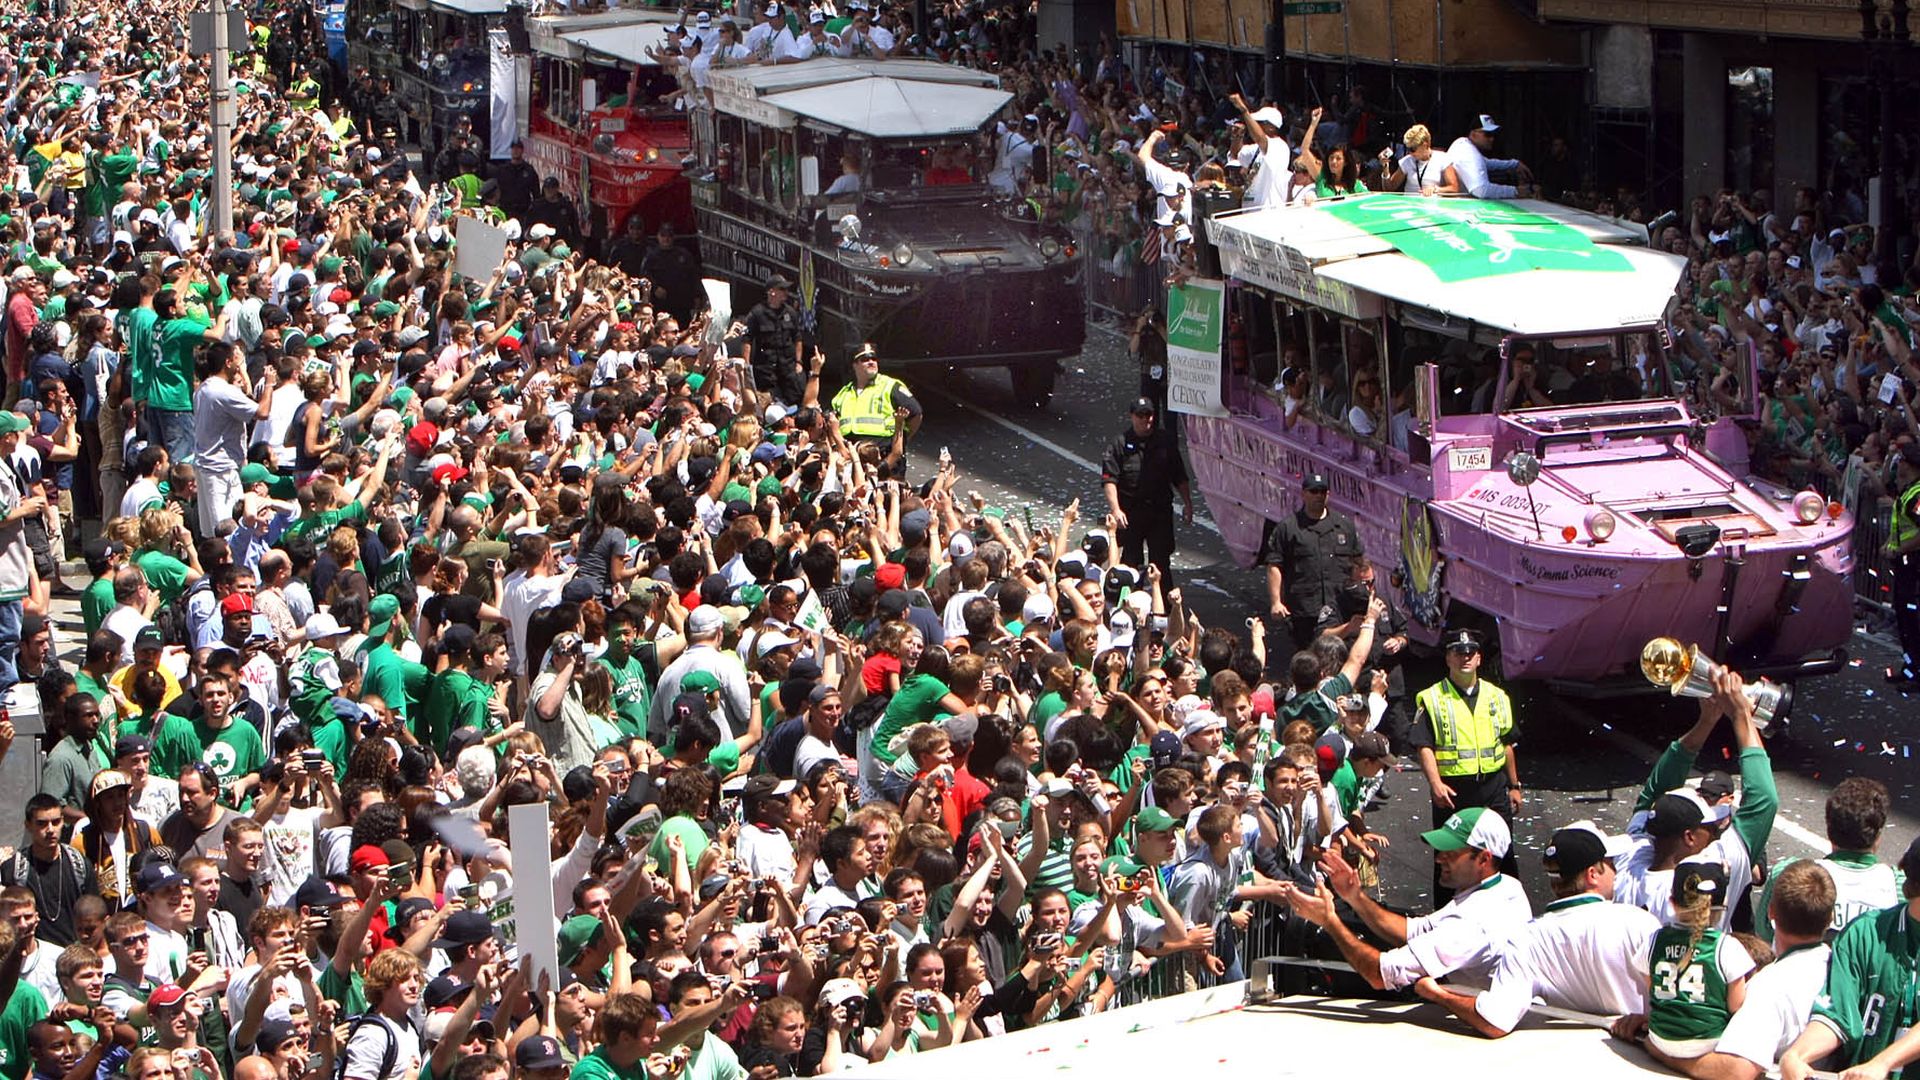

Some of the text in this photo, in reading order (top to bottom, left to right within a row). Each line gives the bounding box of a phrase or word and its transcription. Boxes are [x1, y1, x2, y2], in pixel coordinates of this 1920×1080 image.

[1172, 384, 1207, 409] CELTICS
[1457, 453, 1486, 467] 17454
[1325, 465, 1365, 500] TOURS
[1478, 489, 1499, 503] MS
[1536, 566, 1569, 581] Emma
[1665, 945, 1700, 962] PIERE
[1654, 961, 1706, 1004] 34
